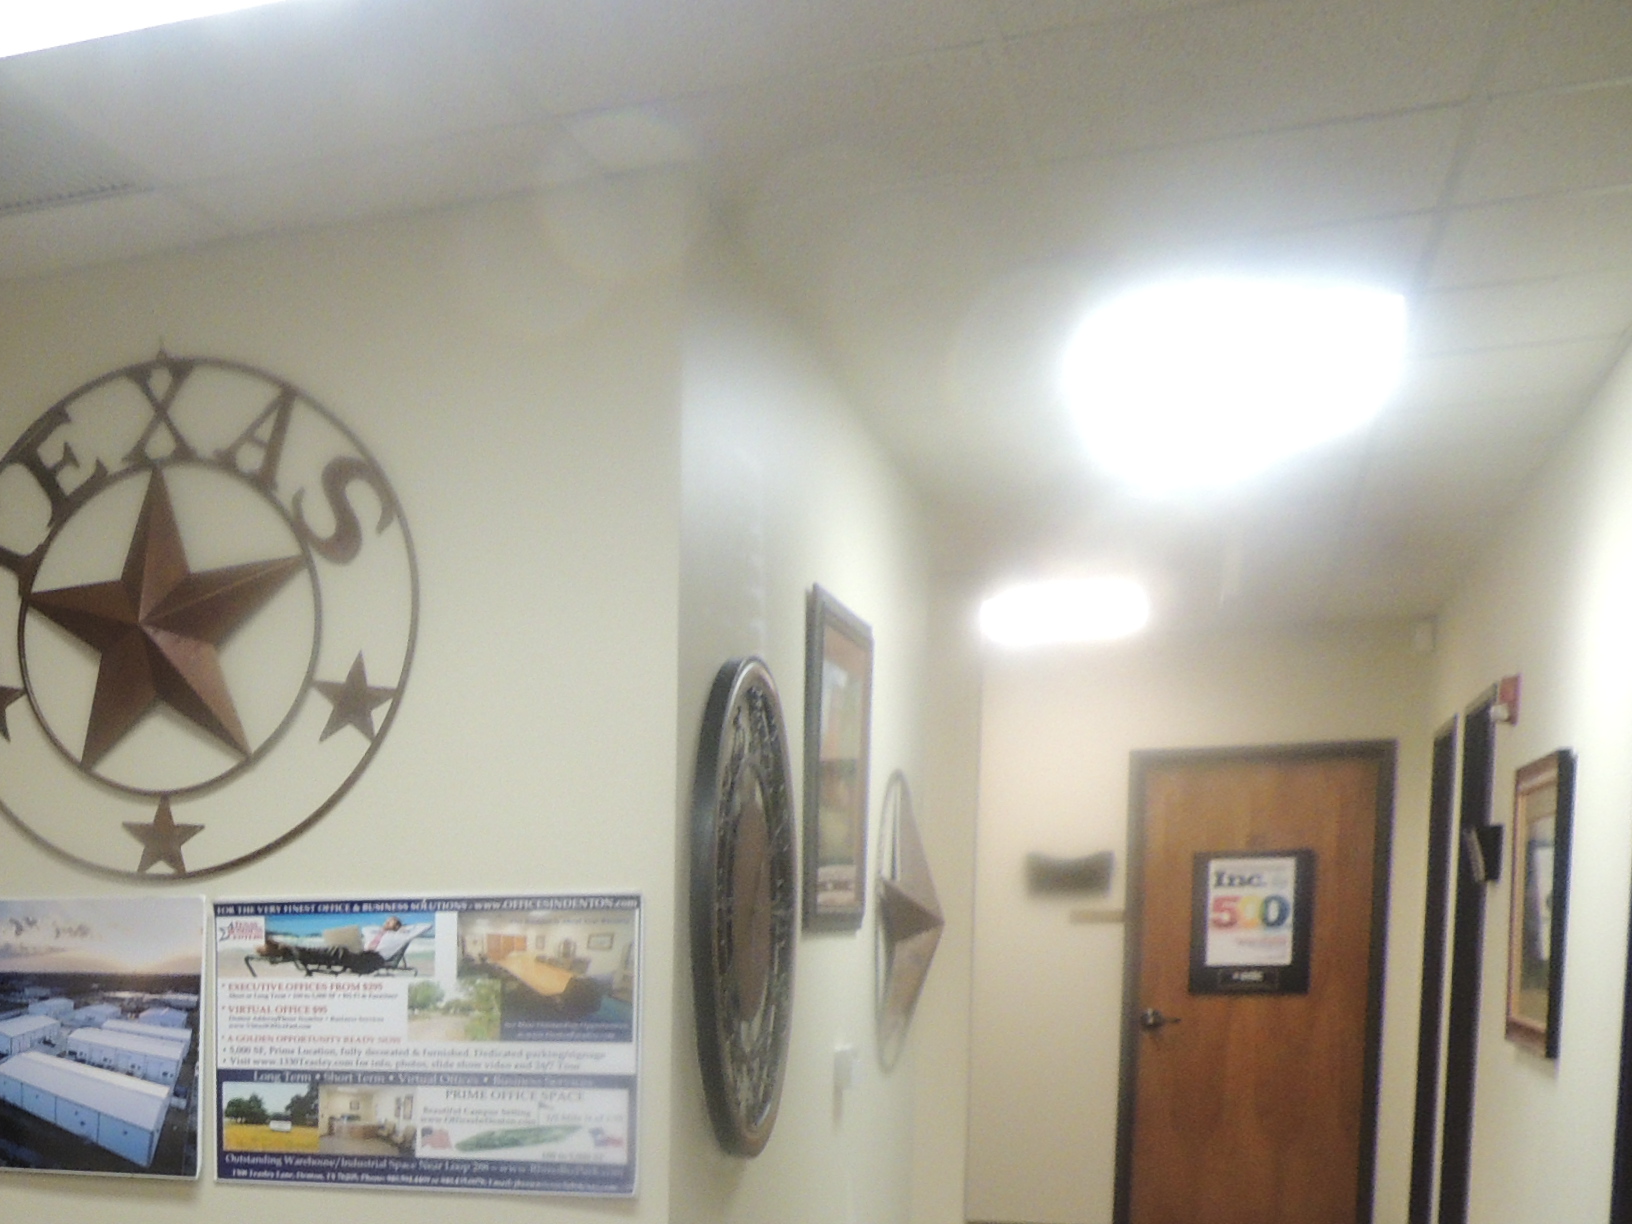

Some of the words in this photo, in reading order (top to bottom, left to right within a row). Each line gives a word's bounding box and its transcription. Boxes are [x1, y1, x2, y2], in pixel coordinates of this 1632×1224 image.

[318, 902, 350, 913] OFFICE
[362, 902, 409, 912] BUSINESS
[1212, 894, 1291, 929] 500
[228, 982, 282, 991] EXECUTIVE
[285, 982, 327, 991] OFFICES
[330, 982, 360, 991] FROM
[228, 1004, 271, 1014] VIRTUAL
[274, 1005, 310, 1014] OFFICE
[269, 1046, 295, 1055] Prime
[253, 1070, 281, 1083] Long
[285, 1071, 312, 1083] Term
[323, 1071, 353, 1083] Short
[358, 1072, 385, 1084] Term
[445, 1089, 486, 1100] PRIME
[490, 1090, 536, 1101] OFFICE
[225, 1153, 283, 1168] Outstanding
